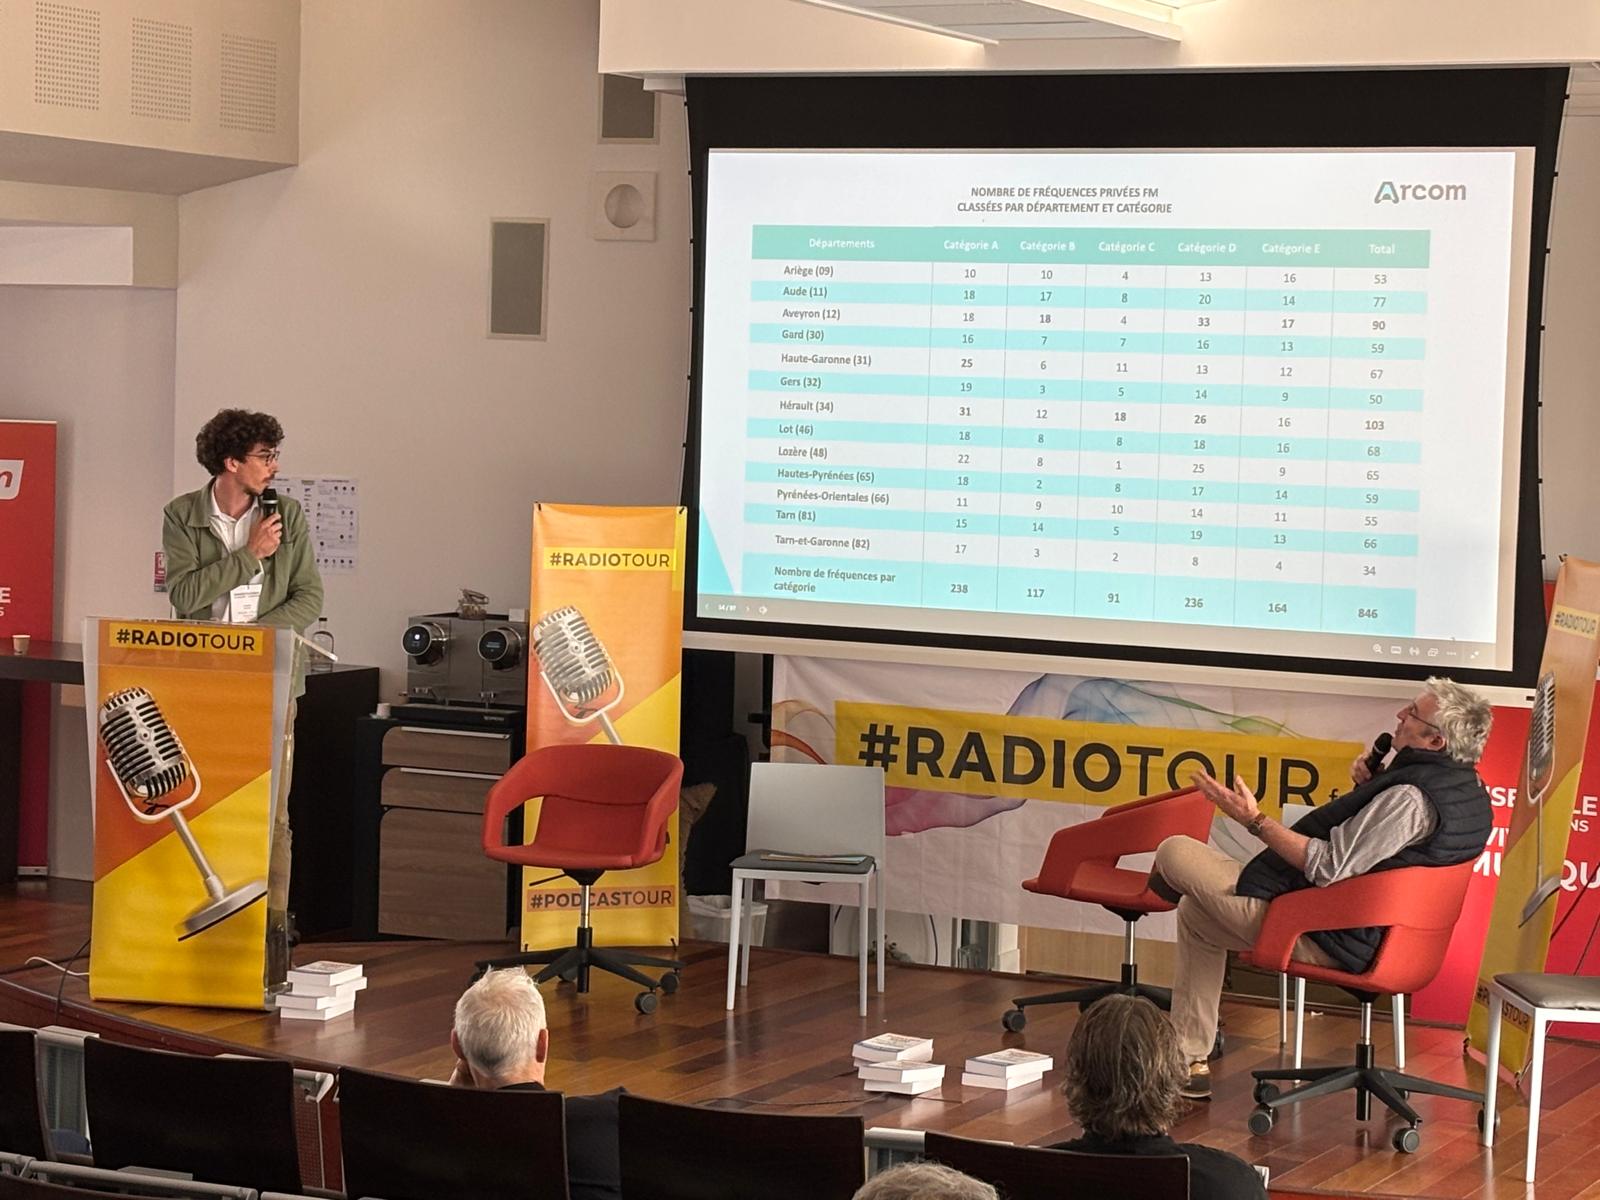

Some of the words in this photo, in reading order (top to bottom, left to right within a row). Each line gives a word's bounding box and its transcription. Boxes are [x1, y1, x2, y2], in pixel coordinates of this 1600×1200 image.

[971, 187, 1015, 197] NOMBRE
[1018, 187, 1031, 197] DE
[1033, 186, 1097, 198] FRÉQUENCES
[1100, 186, 1141, 197] PRIVÉES
[1143, 188, 1159, 198] FM
[1374, 181, 1466, 204] Arcom
[957, 201, 1002, 212] CLASSÉES
[1005, 203, 1024, 212] PAR
[1027, 201, 1100, 213] DÉPARTEMENT
[1102, 203, 1115, 213] ET
[1116, 202, 1173, 213] CATÉGORIE
[809, 238, 875, 250] Départements
[944, 240, 989, 252] Catégorie
[991, 241, 999, 250] A
[1020, 240, 1067, 253] Catégorie
[1069, 242, 1076, 251] B
[1099, 241, 1146, 254] Catégorie
[1148, 242, 1155, 252] C
[1178, 242, 1225, 255] Catégorie
[1226, 244, 1237, 253] D
[1262, 243, 1311, 256] Catégorie
[1313, 244, 1321, 254] E
[1369, 244, 1395, 255] Total
[784, 265, 812, 278] Ariège
[815, 266, 834, 278] (09)
[964, 269, 977, 279] 10
[1040, 270, 1054, 280] 10
[1121, 272, 1129, 281] 4
[1199, 272, 1212, 283] 13
[1283, 273, 1297, 284] 16
[1374, 274, 1388, 285] 53
[783, 286, 807, 296] Aude
[809, 287, 828, 298] (11)
[963, 290, 976, 300] 18
[1040, 292, 1053, 302] 17
[1121, 293, 1128, 304] 8
[1198, 294, 1212, 305] 20
[1282, 296, 1296, 306] 14
[1373, 297, 1387, 308] 77
[782, 308, 820, 320] Aveyron
[822, 309, 840, 321] (12)
[963, 313, 975, 322] 18
[1039, 314, 1052, 324] 18
[1120, 316, 1127, 325] 4
[1197, 317, 1211, 328] 33
[1281, 319, 1296, 329] 17
[1372, 321, 1386, 331] 90
[782, 330, 804, 339] Gard
[806, 330, 824, 341] (30)
[962, 334, 975, 344] 16
[1041, 336, 1048, 345] 7
[1120, 338, 1127, 347] 7
[1197, 340, 1210, 350] 16
[1280, 342, 1294, 352] 13
[1371, 344, 1385, 354] 59
[781, 353, 851, 365] Haute-Garonne
[853, 355, 872, 367] (31)
[961, 359, 974, 369] 25
[1040, 361, 1047, 371] 6
[1116, 363, 1129, 373] 11
[1196, 365, 1209, 375] 13
[1279, 367, 1293, 377] 12
[1369, 369, 1384, 380] 67
[780, 377, 801, 386] Gers
[803, 377, 821, 389] (32)
[960, 383, 973, 392] 19
[1039, 385, 1046, 395] 3
[1117, 387, 1125, 397] 5
[1195, 390, 1208, 400] 14
[1281, 392, 1289, 402] 9
[1369, 395, 1383, 405] 50
[780, 401, 813, 411] Hérault
[815, 401, 834, 413] (34)
[959, 407, 971, 417] 31
[1036, 410, 1048, 420] 12
[1114, 412, 1127, 422] 18
[1194, 415, 1207, 425] 26
[1278, 418, 1291, 428] 16
[1365, 421, 1385, 431] 103
[779, 424, 793, 434] Lot
[795, 424, 814, 436] (46)
[959, 432, 971, 441] 18
[1037, 434, 1045, 444] 8
[1116, 437, 1123, 447] 8
[1193, 440, 1206, 450] 18
[1277, 443, 1290, 454] 16
[1367, 446, 1381, 457] 68
[778, 446, 807, 457] Lozère
[809, 447, 828, 459] (48)
[957, 455, 970, 464] 22
[1036, 457, 1044, 467] 8
[1115, 461, 1122, 471] 1
[1192, 464, 1205, 474] 25
[1279, 467, 1286, 477] 9
[1366, 471, 1380, 481] 65
[777, 469, 854, 481] Hautes-Pyrénées
[856, 471, 875, 483] (65)
[957, 477, 969, 486] 18
[1036, 480, 1043, 490] 2
[1114, 483, 1121, 493] 8
[1191, 487, 1205, 497] 17
[1275, 490, 1288, 500] 14
[1365, 494, 1379, 504] 59
[777, 489, 869, 502] Pyrénées-Orientales
[871, 493, 890, 505] (66)
[956, 498, 969, 508] 11
[1035, 501, 1042, 511] 9
[1111, 505, 1124, 515] 10
[1191, 509, 1203, 519] 14
[1274, 512, 1287, 523] 11
[1364, 517, 1378, 527] 55
[776, 510, 796, 520] Tarn
[798, 510, 816, 522] (81)
[955, 519, 968, 529] 15
[1032, 523, 1044, 532] 14
[1113, 526, 1120, 536] 5
[1190, 531, 1203, 540] 19
[1273, 535, 1287, 545] 13
[1363, 539, 1378, 549] 66
[549, 552, 670, 568] #RADIOTOUR
[775, 535, 849, 547] Tarn-et-Garonne
[851, 538, 870, 550] (82)
[954, 545, 967, 554] 17
[1033, 549, 1041, 558] 3
[1111, 553, 1119, 562] 2
[1191, 557, 1199, 567] 8
[1275, 561, 1283, 571] 4
[1362, 566, 1377, 576] 34
[774, 582, 816, 593] catégorie
[774, 566, 811, 577] Nombre
[813, 568, 825, 578] de
[827, 569, 878, 582] fréquences
[880, 573, 896, 584] par
[950, 584, 969, 594] 238
[1027, 589, 1045, 599] 117
[1107, 593, 1120, 604] 91
[1184, 598, 1204, 609] 236
[1268, 603, 1288, 614] 164
[1357, 609, 1379, 619] 846
[116, 628, 255, 651] #RADIOTOUR
[858, 723, 1320, 809] #RADIOTOUR
